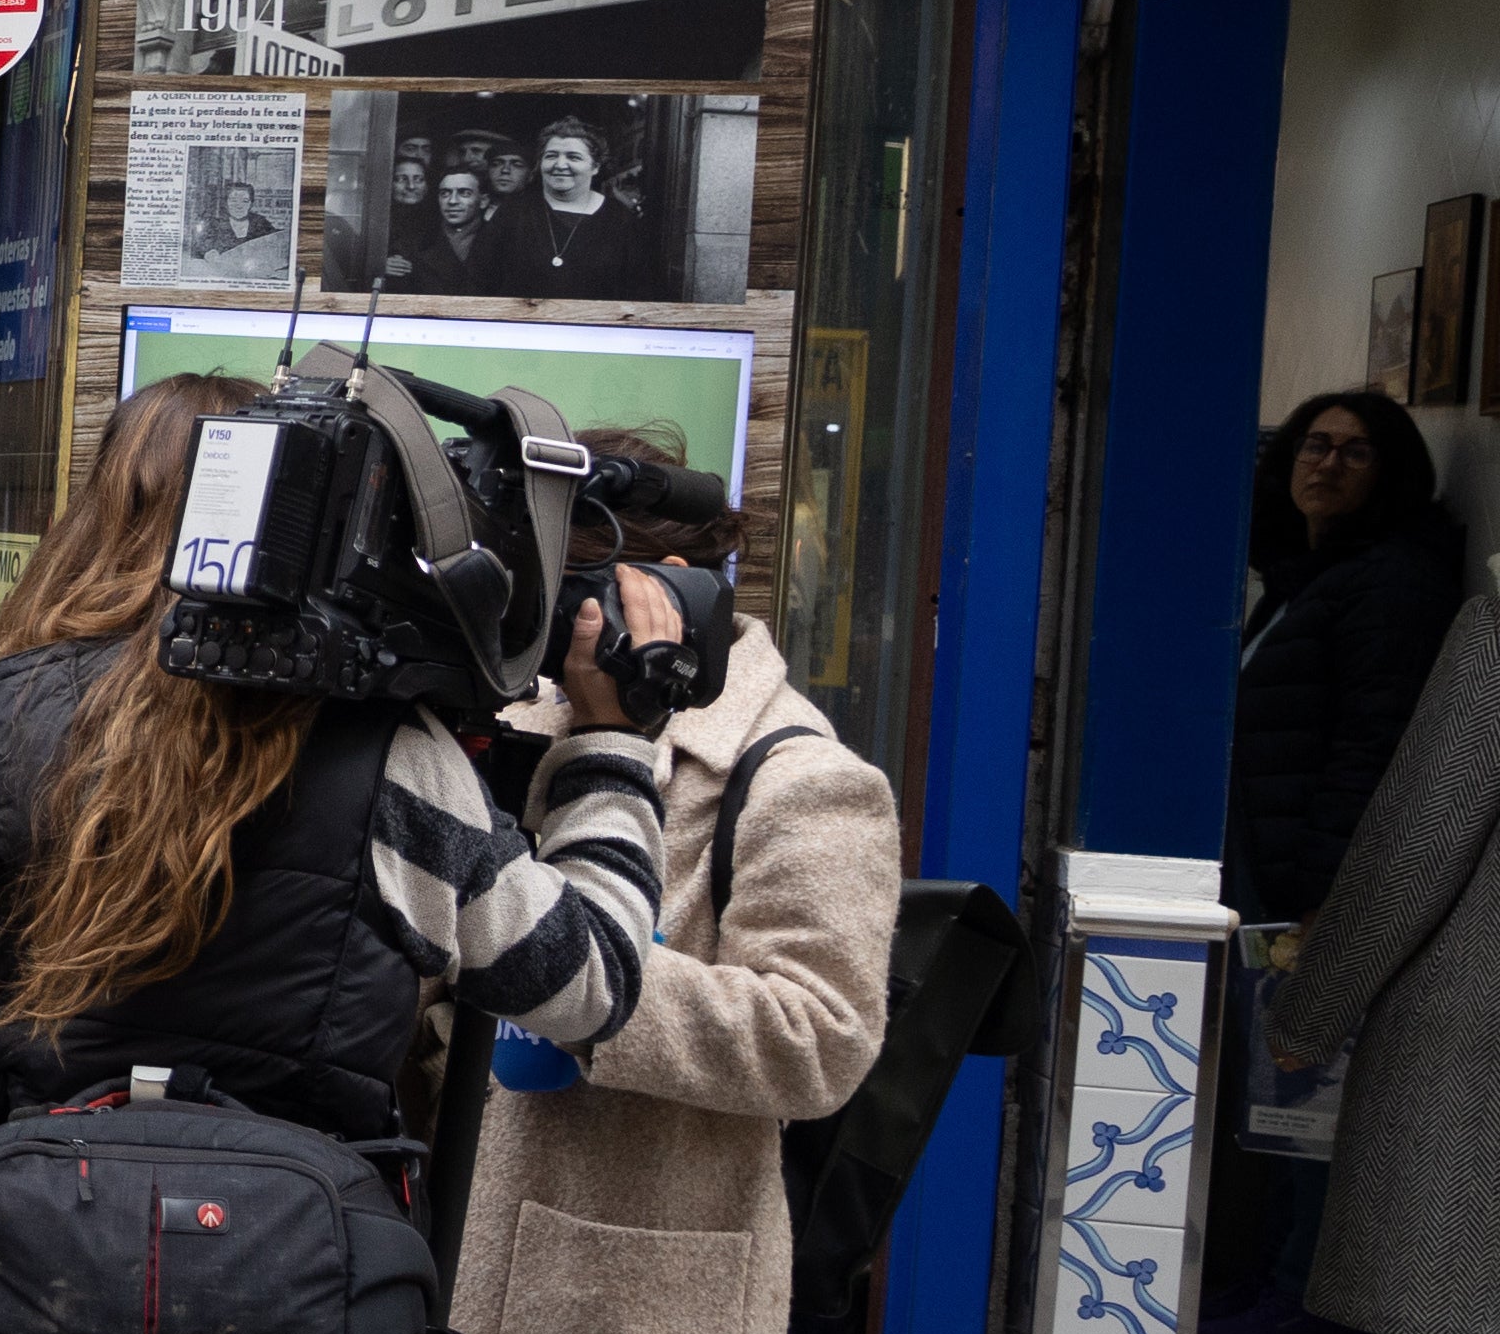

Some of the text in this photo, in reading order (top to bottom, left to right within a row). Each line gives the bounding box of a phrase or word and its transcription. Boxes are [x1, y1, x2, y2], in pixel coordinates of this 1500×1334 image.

[131, 105, 147, 116] La
[30, 235, 40, 268] y
[32, 276, 49, 309] del
[207, 428, 232, 441] V150
[182, 537, 257, 595] 150
